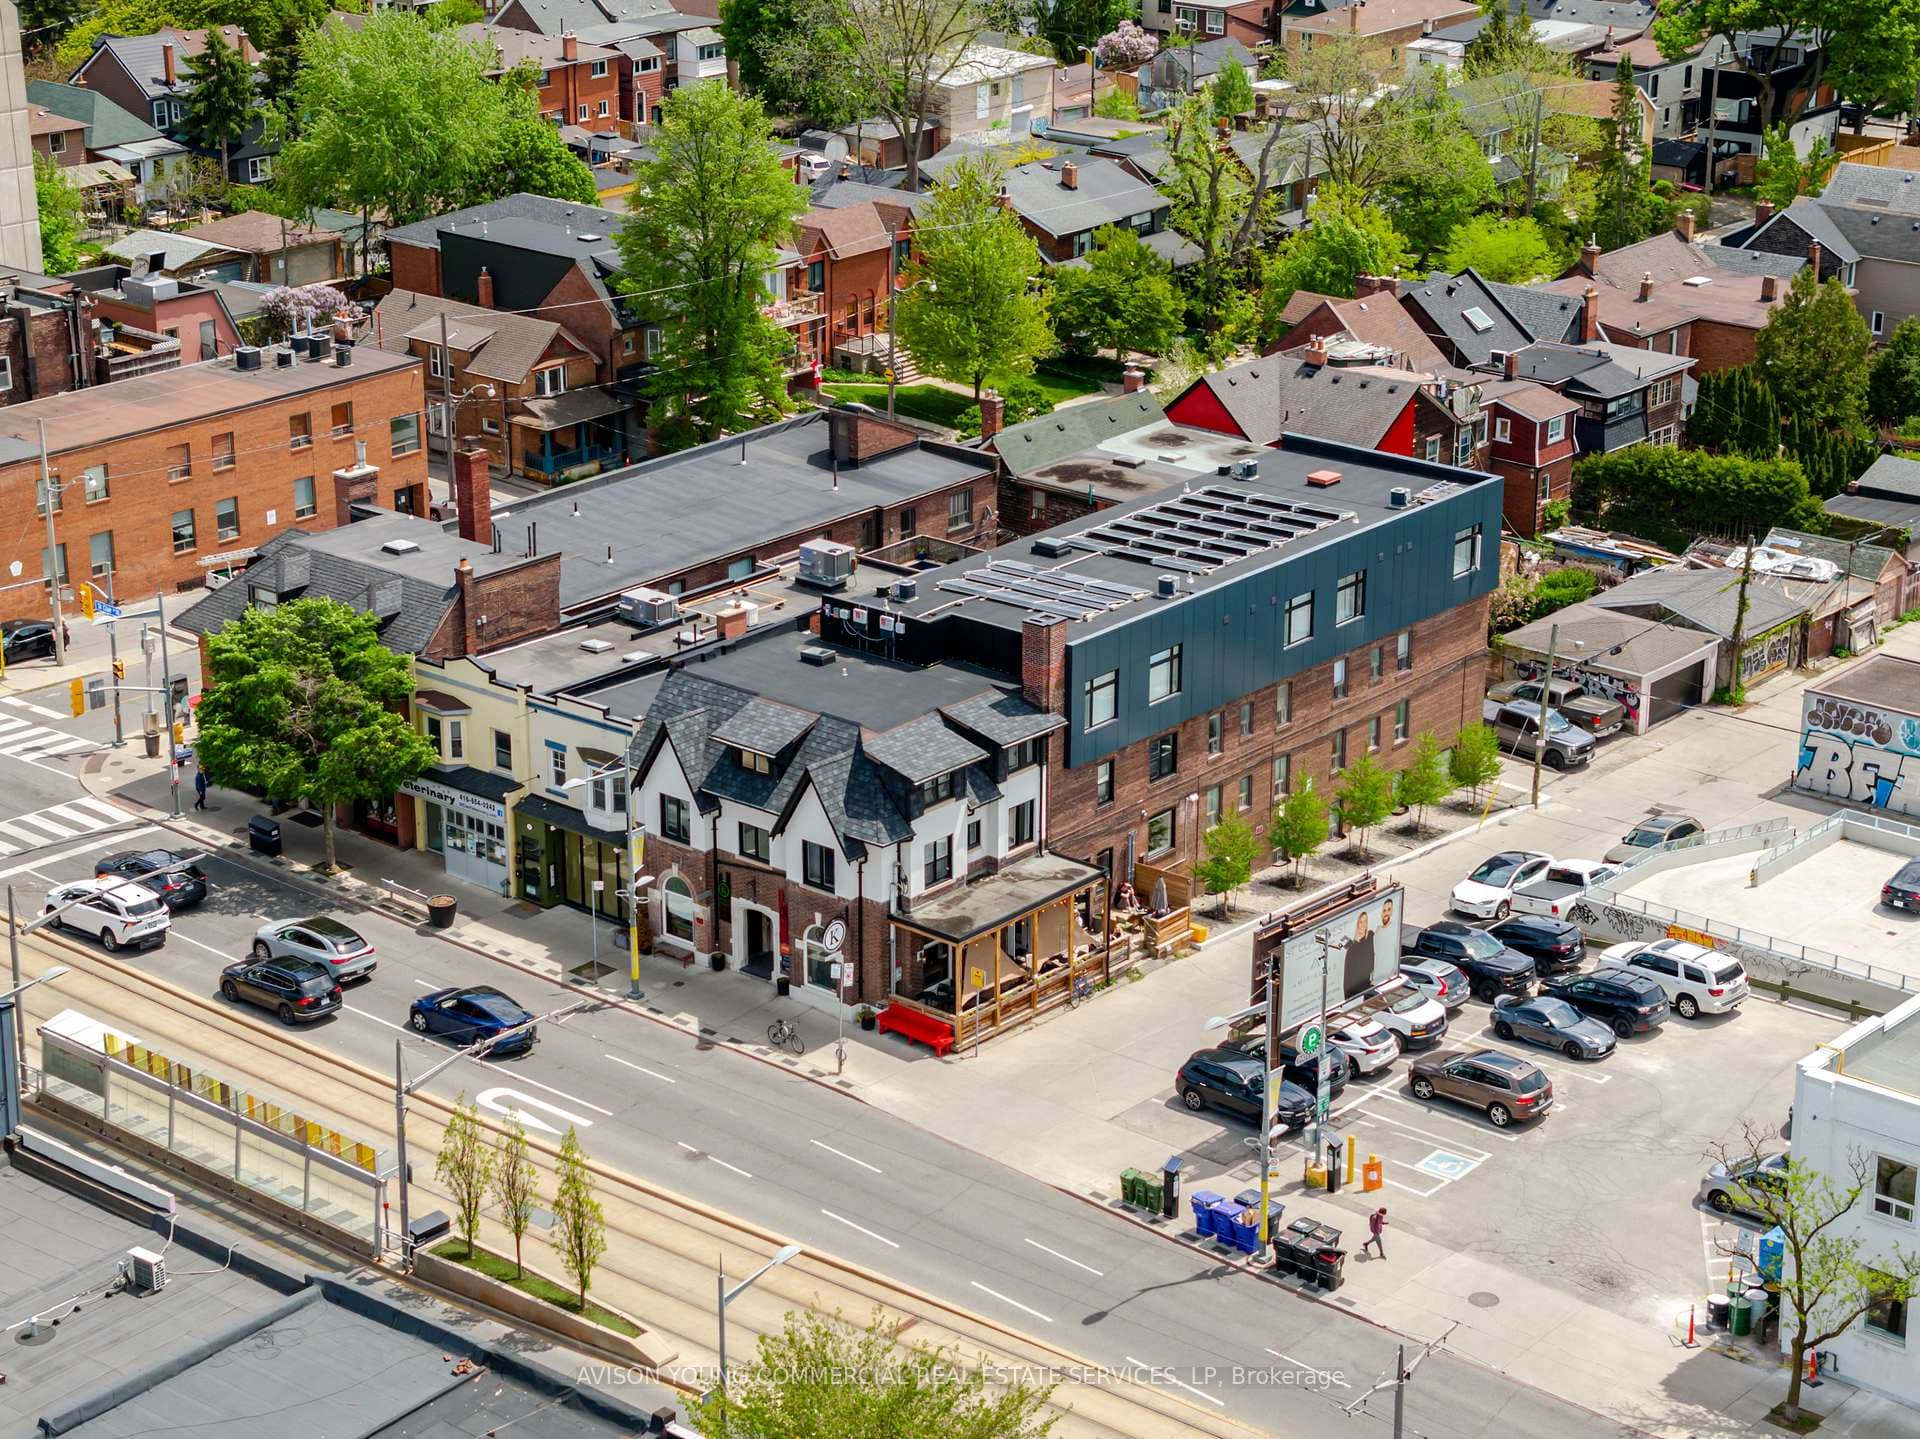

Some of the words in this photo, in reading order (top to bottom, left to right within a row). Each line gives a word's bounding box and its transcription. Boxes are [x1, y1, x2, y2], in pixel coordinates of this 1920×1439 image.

[403, 781, 455, 804] eterinary
[830, 927, 839, 945] K
[1308, 1032, 1317, 1047] P
